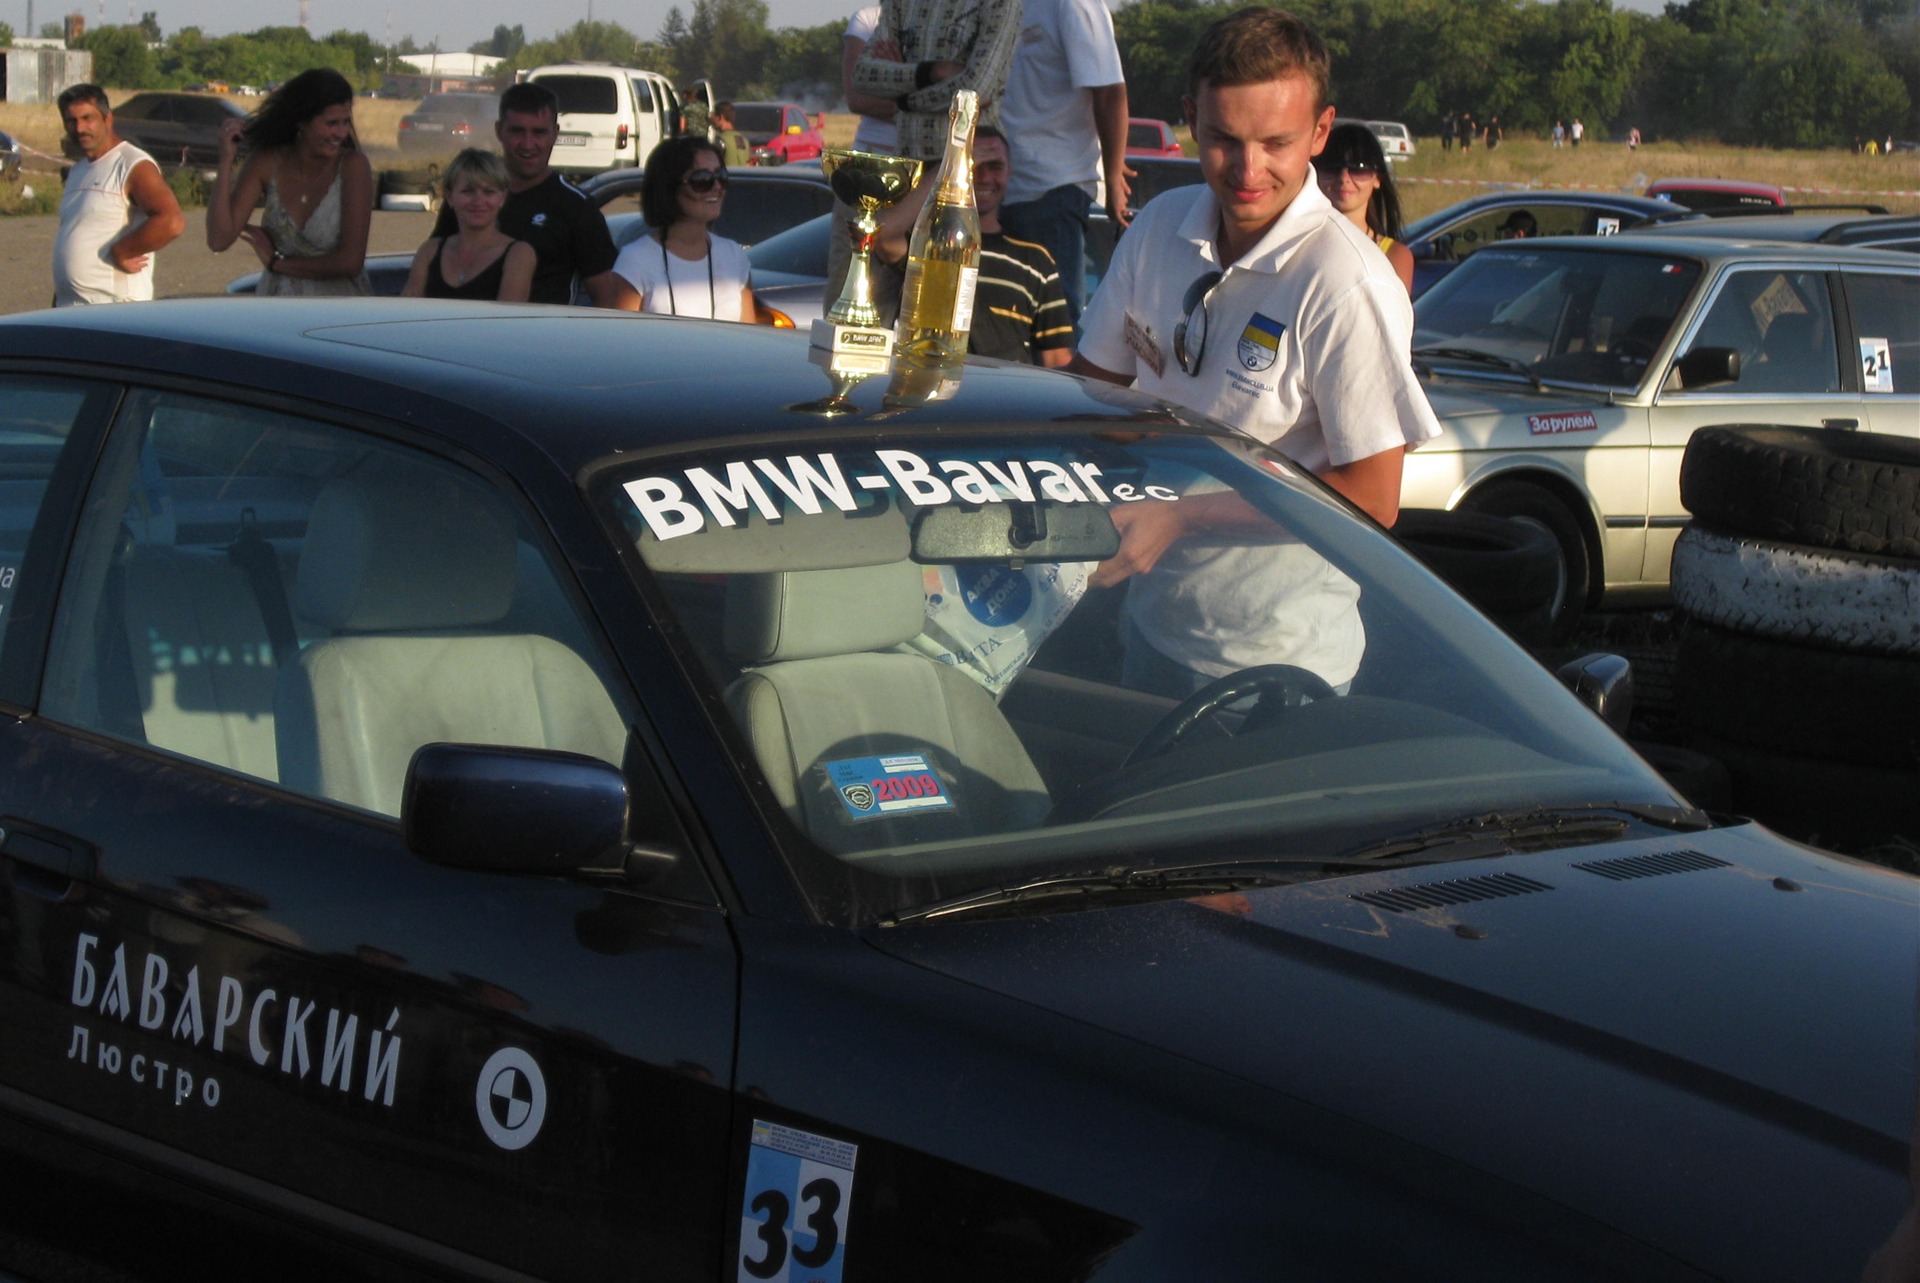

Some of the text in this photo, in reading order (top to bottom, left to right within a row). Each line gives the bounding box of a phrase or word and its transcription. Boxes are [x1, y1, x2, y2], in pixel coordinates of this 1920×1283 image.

[1864, 349, 1889, 378] 21
[1232, 381, 1260, 399] Bavarec
[985, 578, 1017, 616] ДОМ
[871, 774, 940, 802] 2009
[72, 932, 401, 1106] БАВАРСКИЙ
[68, 1025, 220, 1107] Люстро
[743, 1177, 841, 1280] 33
